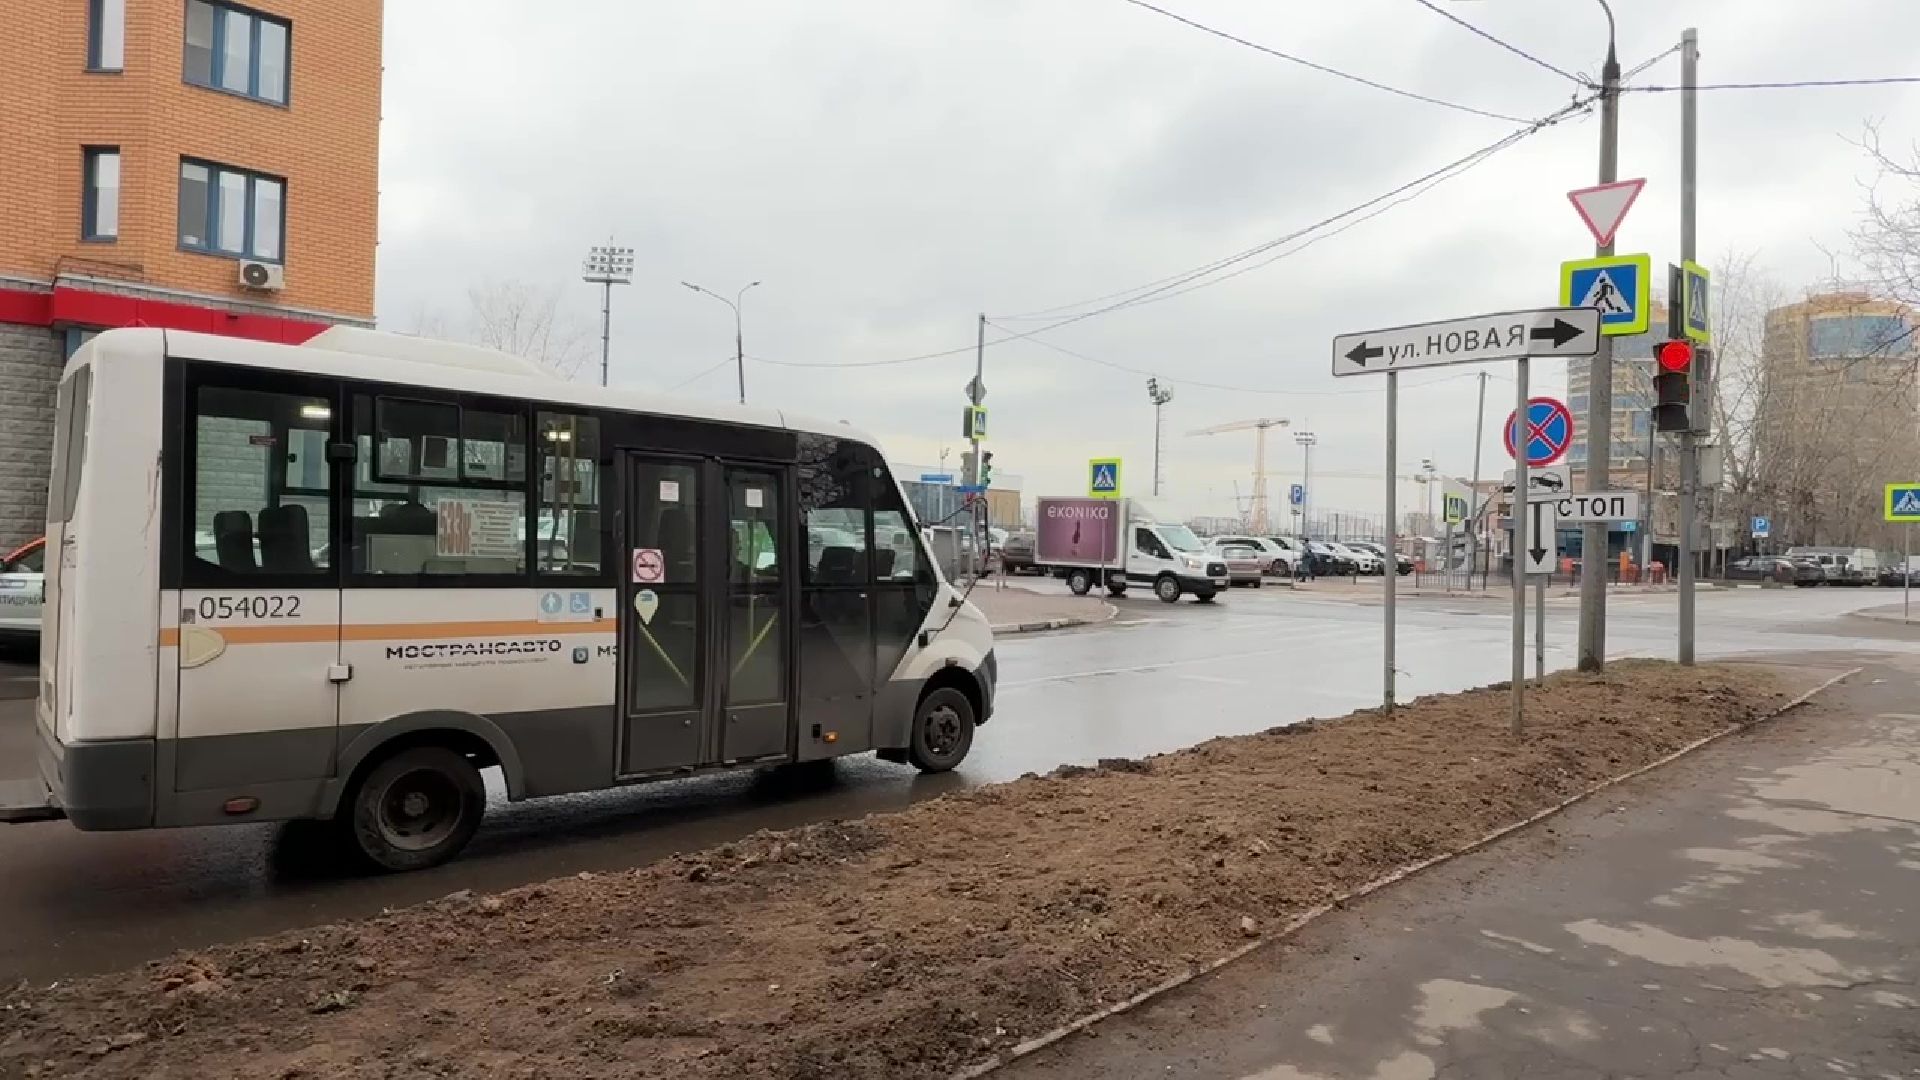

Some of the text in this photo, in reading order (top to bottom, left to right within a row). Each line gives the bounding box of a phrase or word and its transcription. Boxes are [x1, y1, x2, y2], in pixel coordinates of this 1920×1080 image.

[1389, 325, 1525, 366] ул. НОВАЯ
[1558, 498, 1625, 517] СТОП
[199, 596, 301, 619] 054022
[386, 639, 562, 660] МОСТРАНСАВТО
